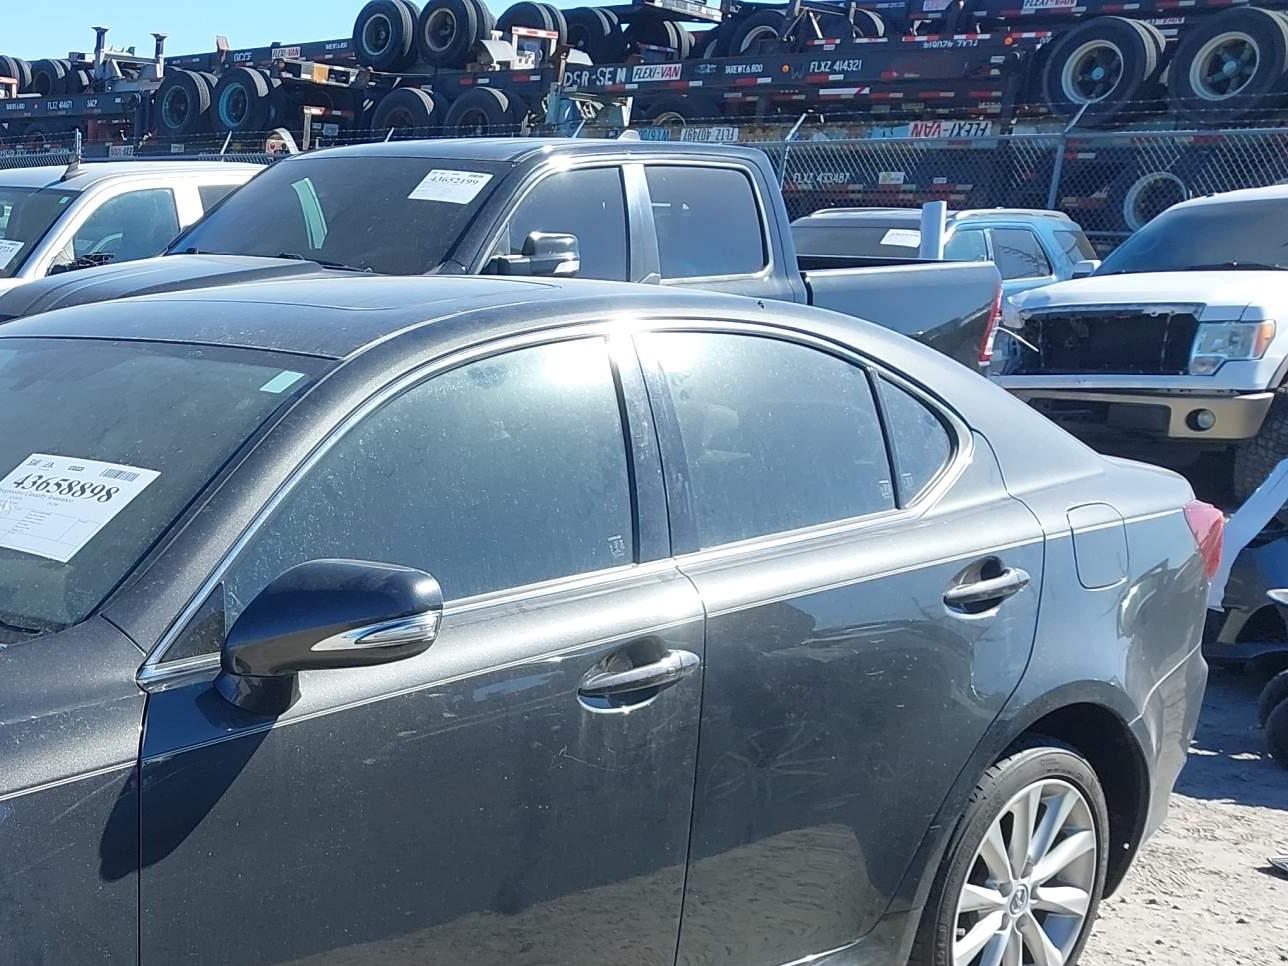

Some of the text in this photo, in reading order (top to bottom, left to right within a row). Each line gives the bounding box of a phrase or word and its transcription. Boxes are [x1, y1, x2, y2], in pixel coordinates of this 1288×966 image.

[633, 66, 680, 80] FLEXI-VAN
[809, 59, 862, 72] FLXZ 414321
[910, 122, 989, 138] FLEXI-VAN
[13, 473, 121, 502] 43658898
